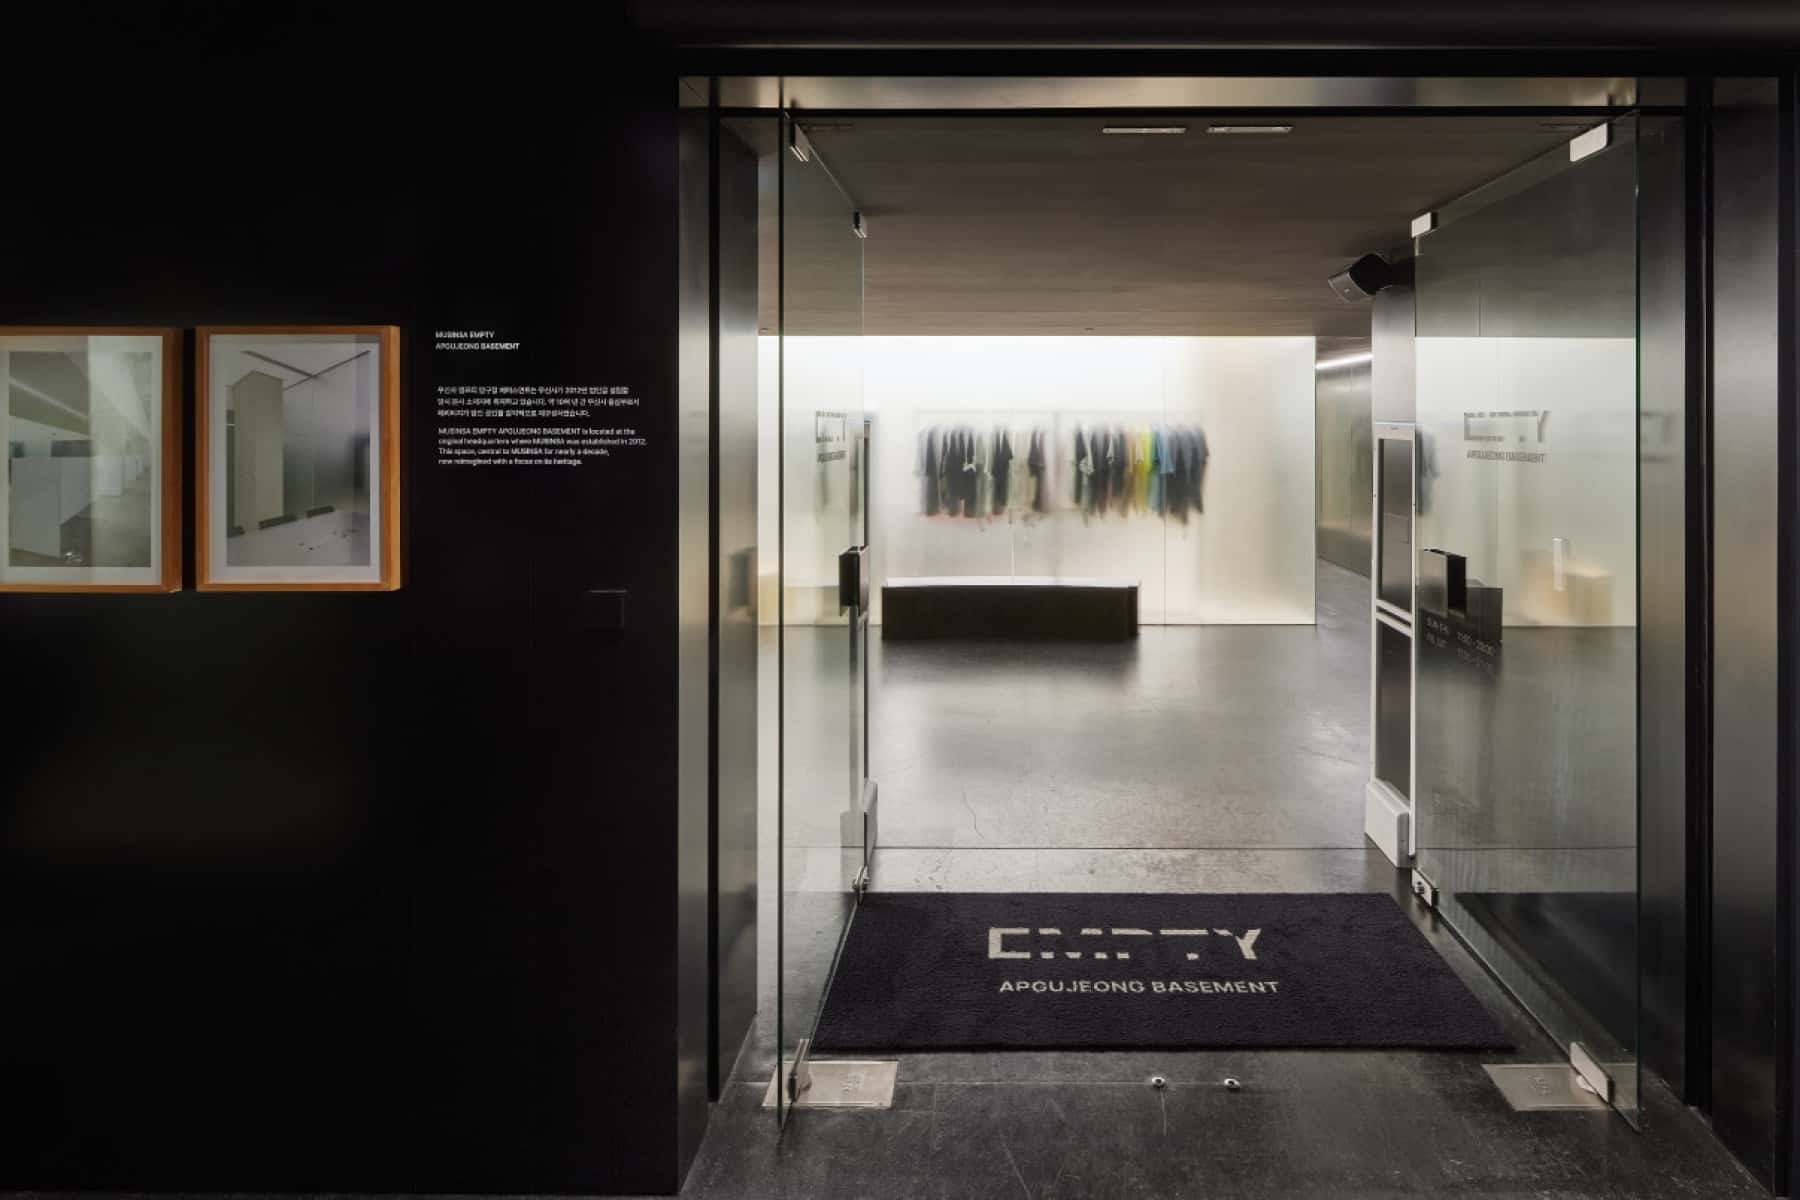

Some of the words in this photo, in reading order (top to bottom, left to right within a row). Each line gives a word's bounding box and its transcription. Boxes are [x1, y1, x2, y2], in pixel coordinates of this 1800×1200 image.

[435, 342, 480, 350] APGUJEONG
[480, 342, 520, 350] BASEMENT
[438, 427, 472, 435] MUSINSA
[472, 427, 497, 435] EMPTY
[497, 427, 542, 435] APGUJEONG
[542, 427, 581, 435] BASEMENT
[589, 427, 615, 435] located
[623, 427, 636, 435] the
[438, 447, 453, 455] This
[511, 447, 544, 455] MUSINSA
[554, 447, 576, 456] nearly
[999, 980, 1145, 993] APGUJEONG
[1151, 980, 1278, 993] BASEMENT
